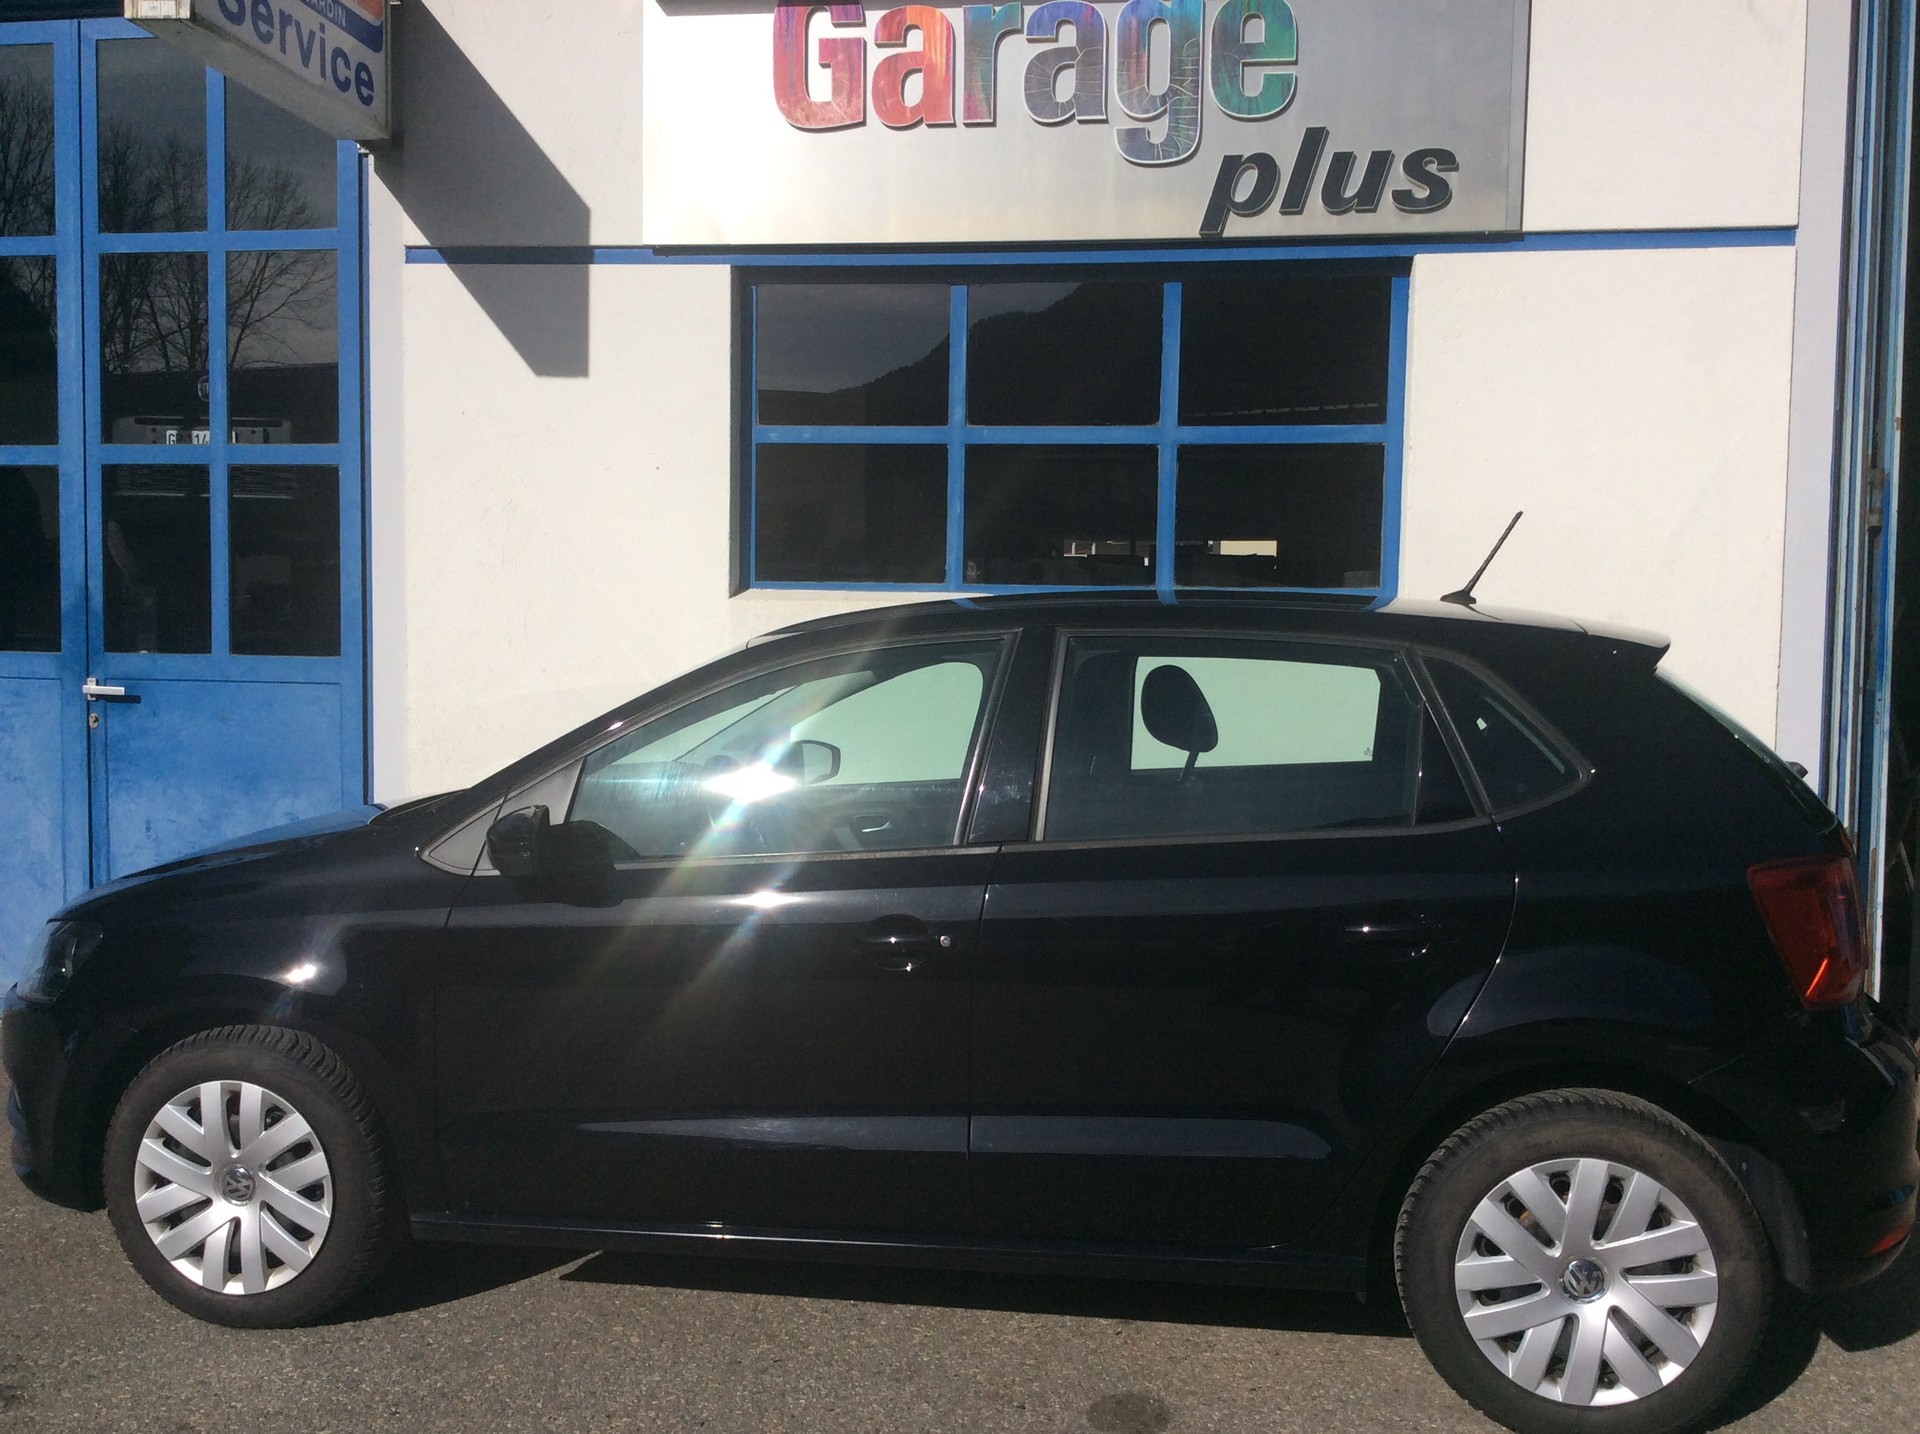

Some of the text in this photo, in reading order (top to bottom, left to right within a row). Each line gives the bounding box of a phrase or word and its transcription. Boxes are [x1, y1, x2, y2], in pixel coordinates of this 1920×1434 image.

[306, 0, 346, 28] ARDIN
[772, 0, 1298, 166] Garage
[1199, 126, 1460, 238] plus
